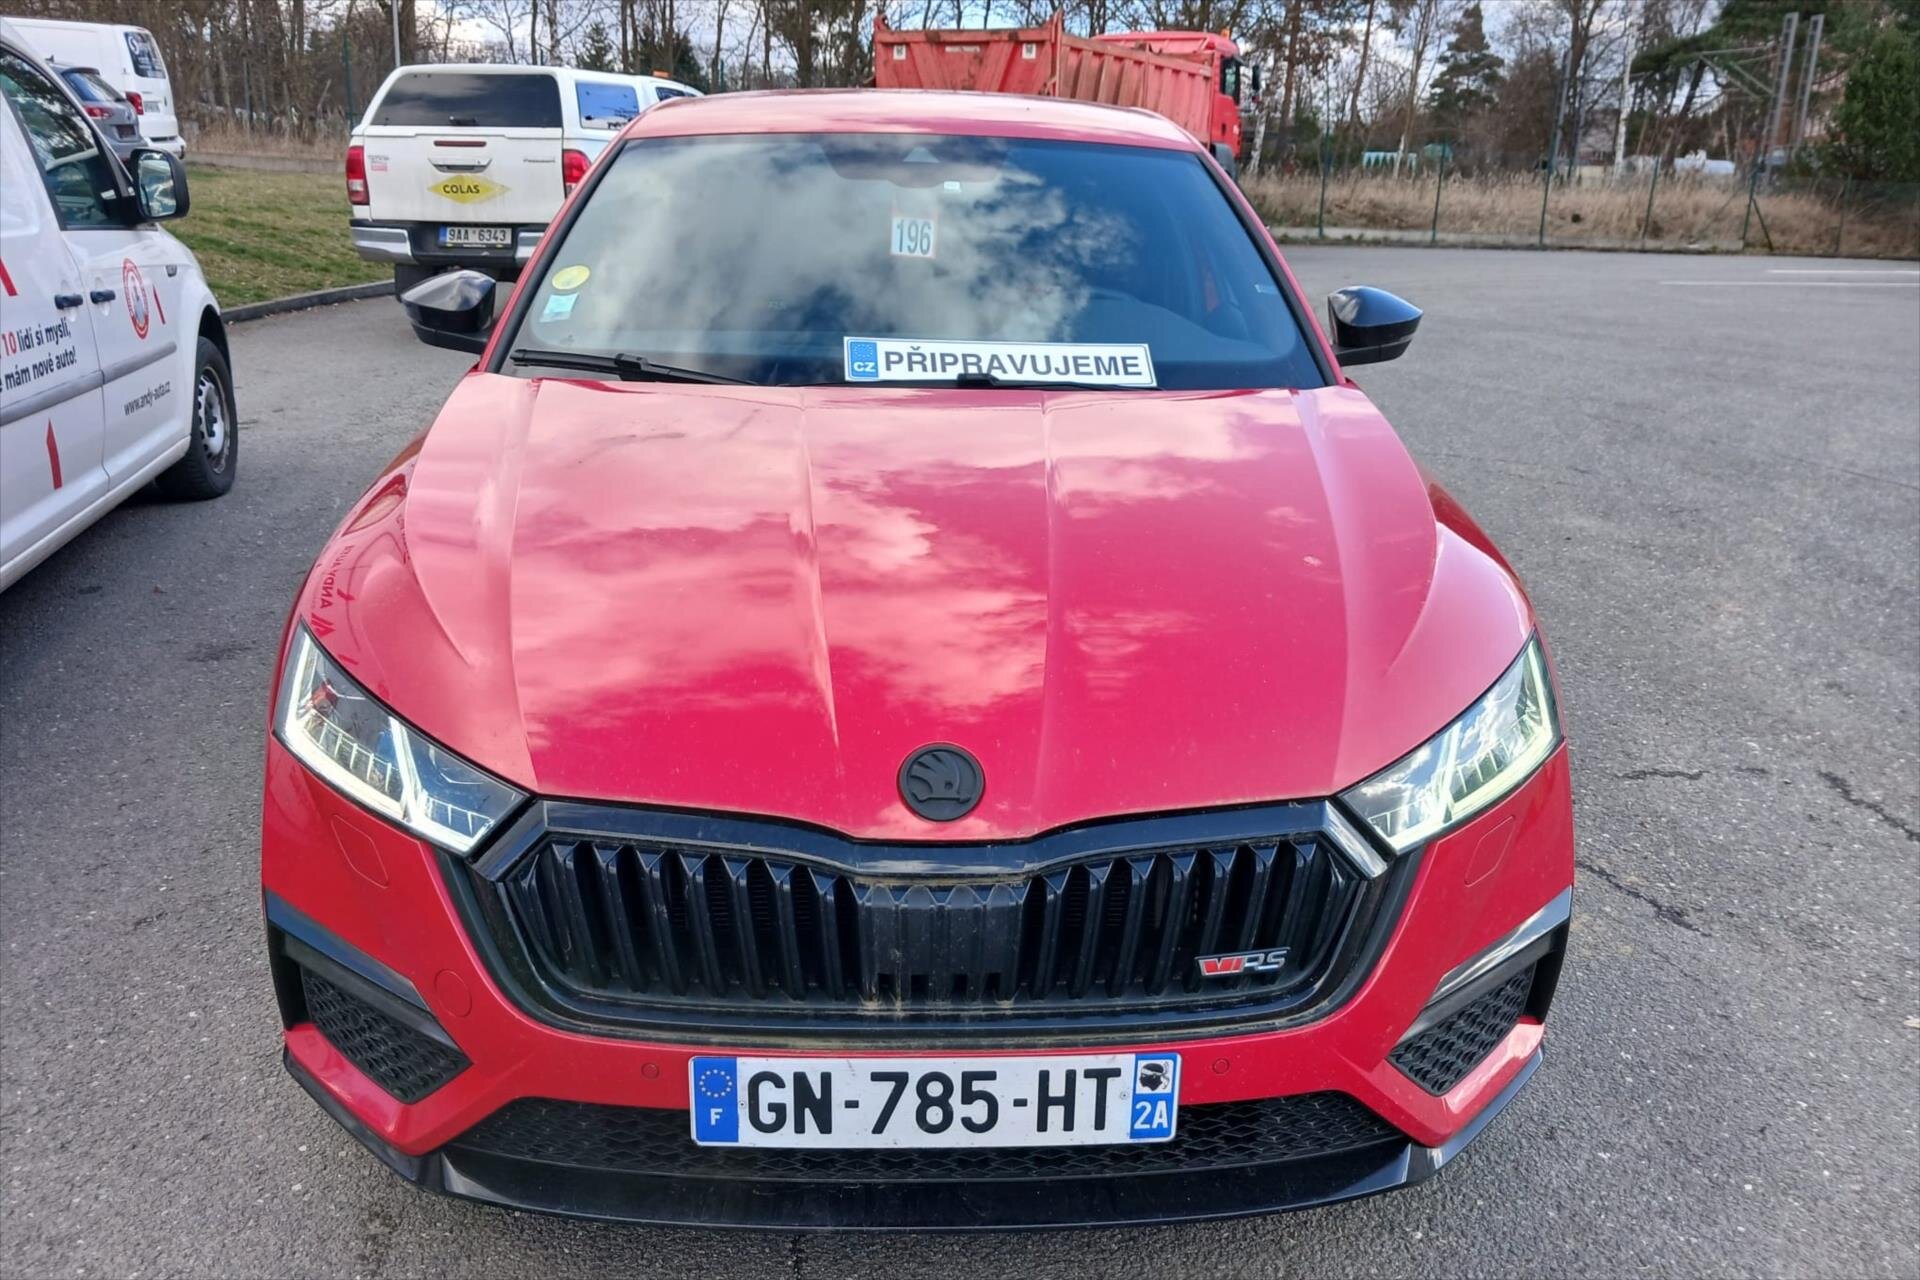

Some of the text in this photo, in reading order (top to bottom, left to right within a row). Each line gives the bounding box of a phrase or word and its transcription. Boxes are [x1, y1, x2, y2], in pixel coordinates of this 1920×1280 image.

[443, 184, 480, 194] COLAS
[448, 228, 506, 242] 9AA 6343
[896, 219, 932, 256] 196
[35, 324, 44, 346] si
[4, 345, 77, 391] mám nové auto!
[853, 361, 877, 373] CZ
[884, 345, 1143, 376] PŘIPRAVUJEME
[747, 1067, 1121, 1135] GN-785-HT
[710, 1107, 723, 1126] F
[1133, 1101, 1168, 1131] 2A
